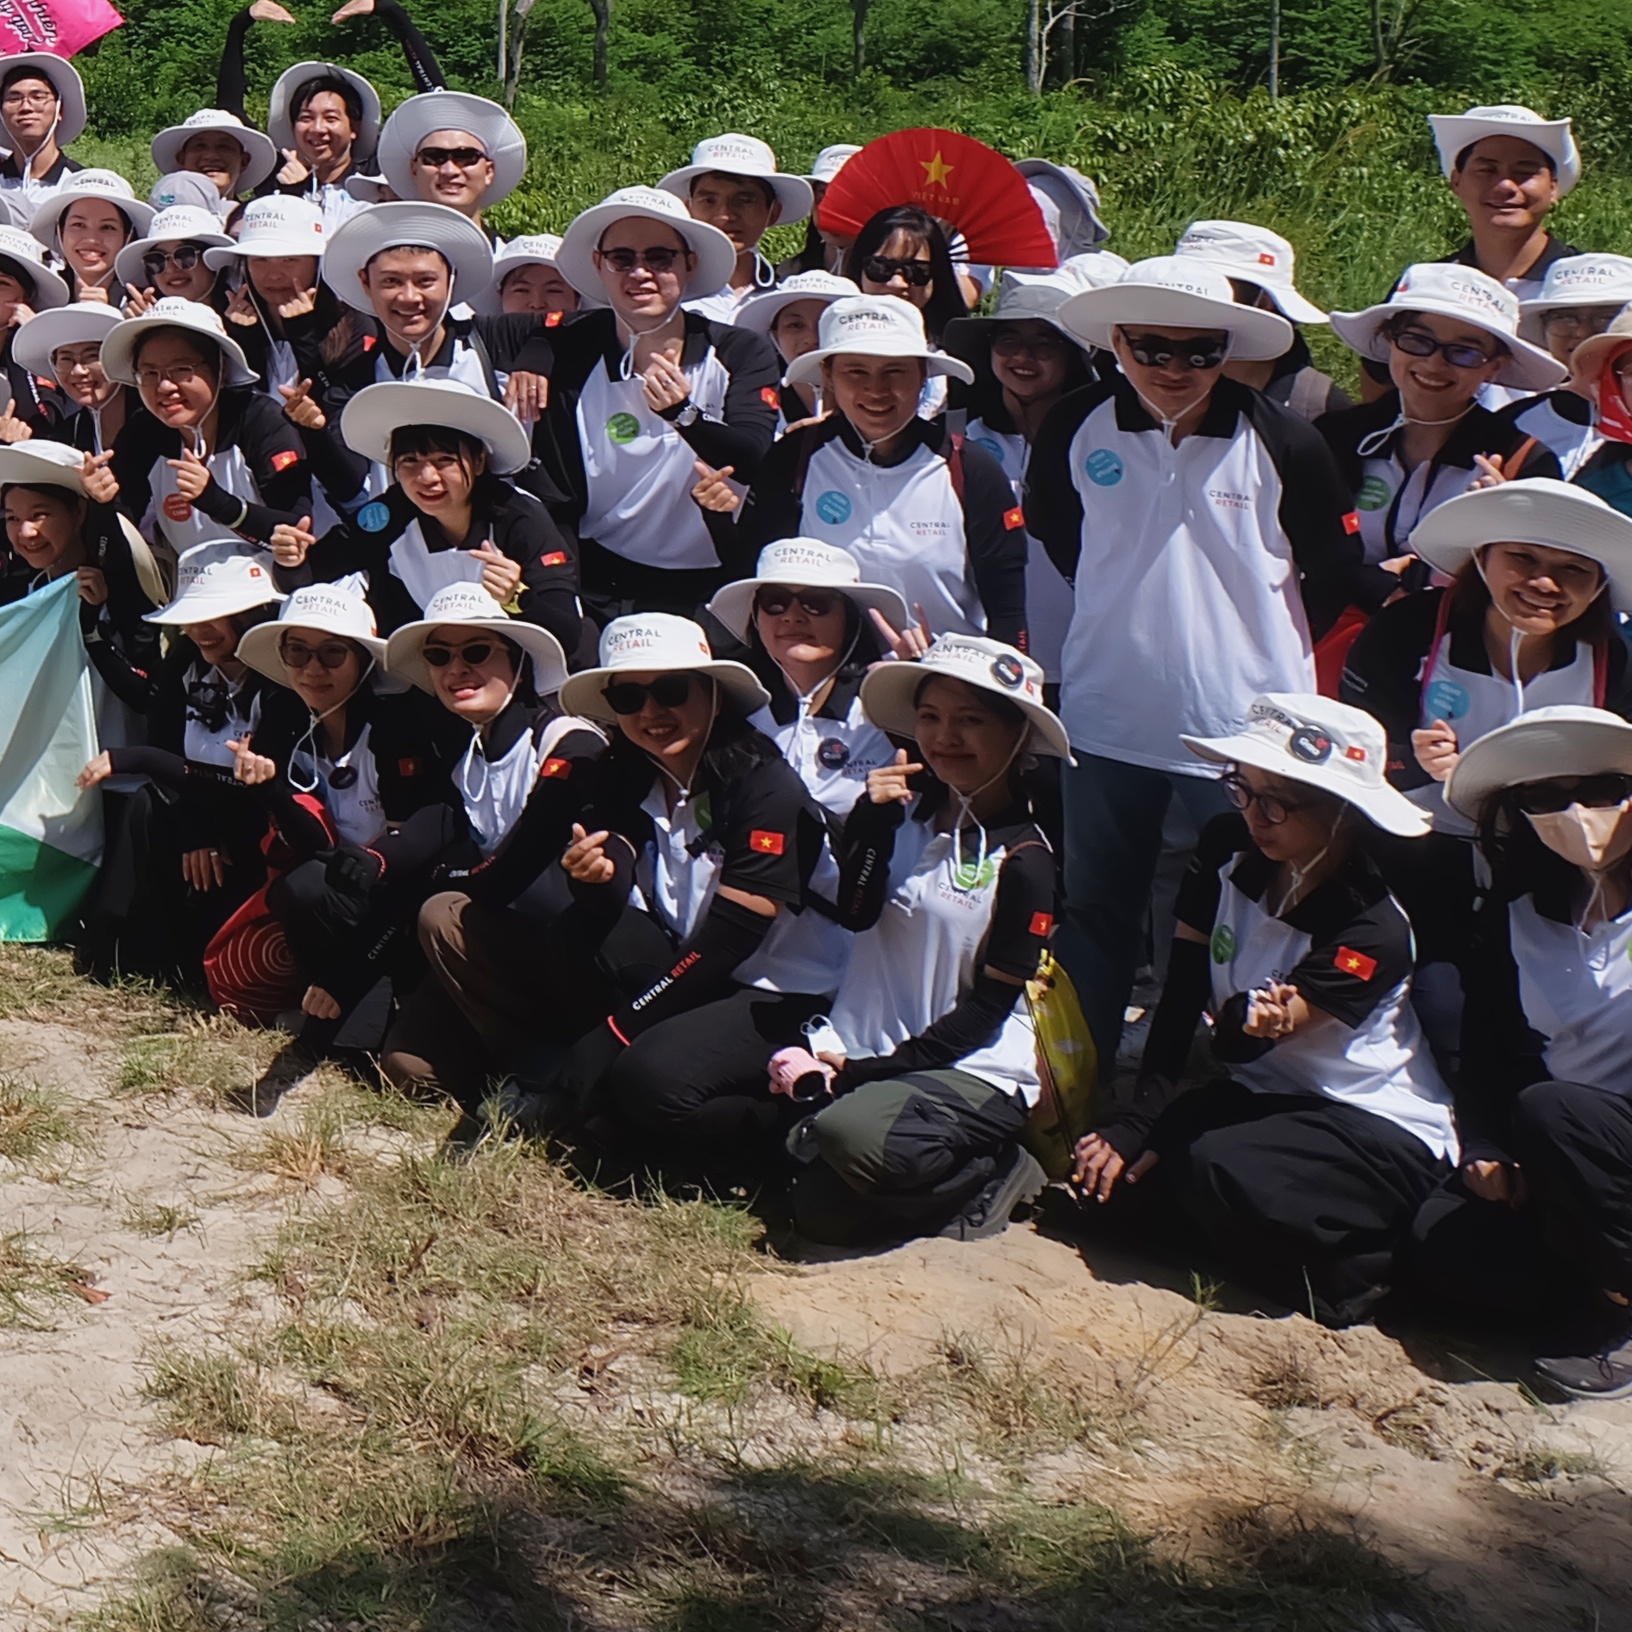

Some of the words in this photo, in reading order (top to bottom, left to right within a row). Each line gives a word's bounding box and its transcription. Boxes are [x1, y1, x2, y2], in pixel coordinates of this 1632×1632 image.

[706, 144, 752, 155] CENTRAL
[245, 213, 285, 222] CENTRAL
[249, 221, 278, 229] RETAIL
[1555, 269, 1615, 282] CENTRAL
[1449, 282, 1503, 312] CENTRAL
[839, 312, 895, 325] CENTRAL
[1215, 499, 1250, 509] RETAIL
[910, 521, 951, 529] CENTRAL
[774, 549, 832, 562] CENTRAL
[780, 556, 822, 566] RETAIL
[295, 596, 346, 612] CENTRAL
[433, 595, 482, 608] CENTRAL
[302, 603, 339, 616] RETAIL
[607, 629, 661, 646] CENTRAL
[612, 639, 653, 652] RETAIL
[857, 848, 876, 887] CENTRAL
[940, 892, 974, 909] RETAIL
[632, 977, 673, 1011] CENTRAL
[670, 951, 702, 978] RETAIL
